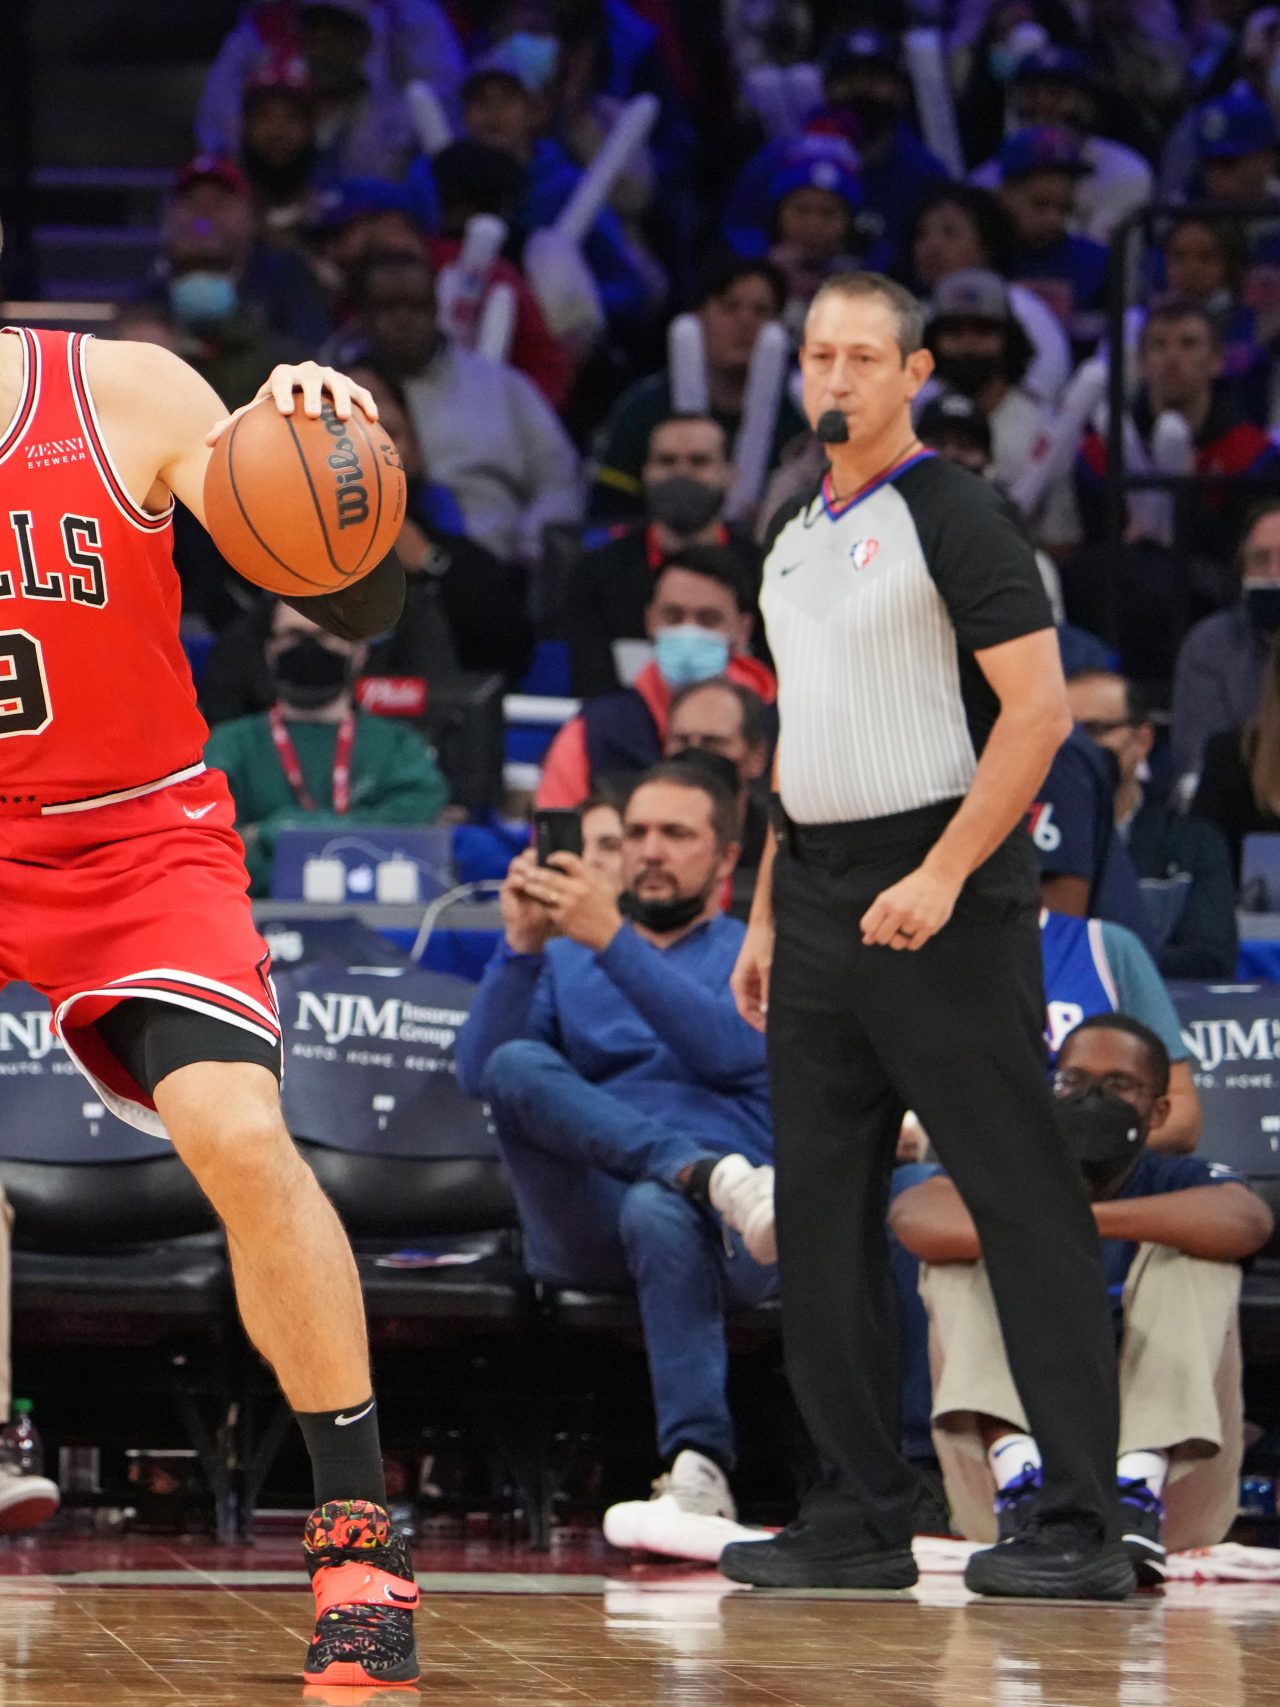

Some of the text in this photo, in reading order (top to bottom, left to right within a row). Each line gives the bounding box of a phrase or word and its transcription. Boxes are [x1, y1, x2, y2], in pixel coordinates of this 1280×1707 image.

[24, 436, 84, 459] ZENNI
[27, 452, 86, 469] EYEWEAR
[293, 990, 402, 1044] NJM
[401, 1001, 470, 1027] Insuran
[399, 1021, 457, 1050] Group
